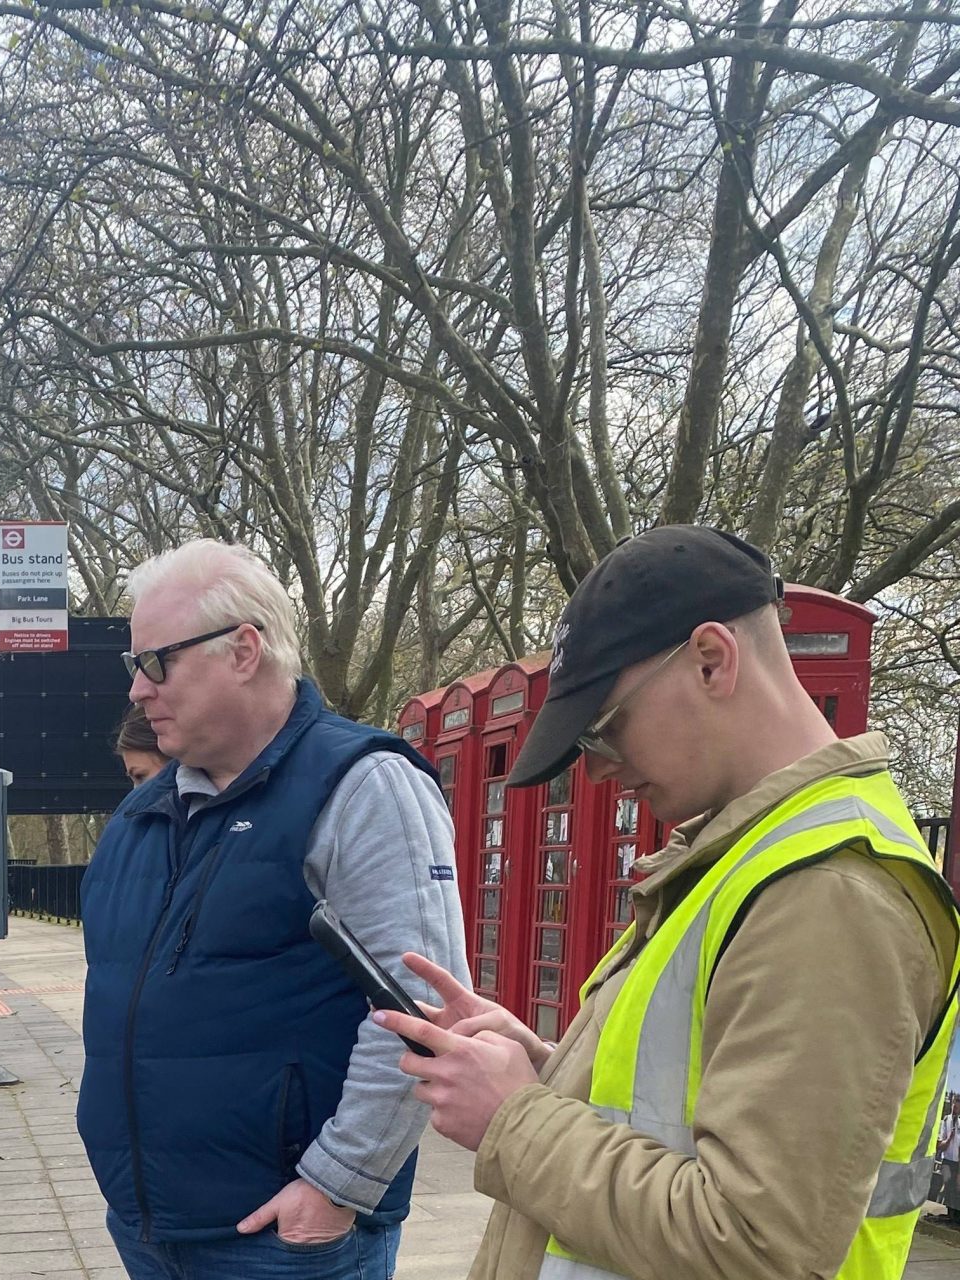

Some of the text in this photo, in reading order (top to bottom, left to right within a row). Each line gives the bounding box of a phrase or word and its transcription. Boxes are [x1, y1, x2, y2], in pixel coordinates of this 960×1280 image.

[2, 553, 62, 564] Bus stand
[11, 616, 22, 624] Big
